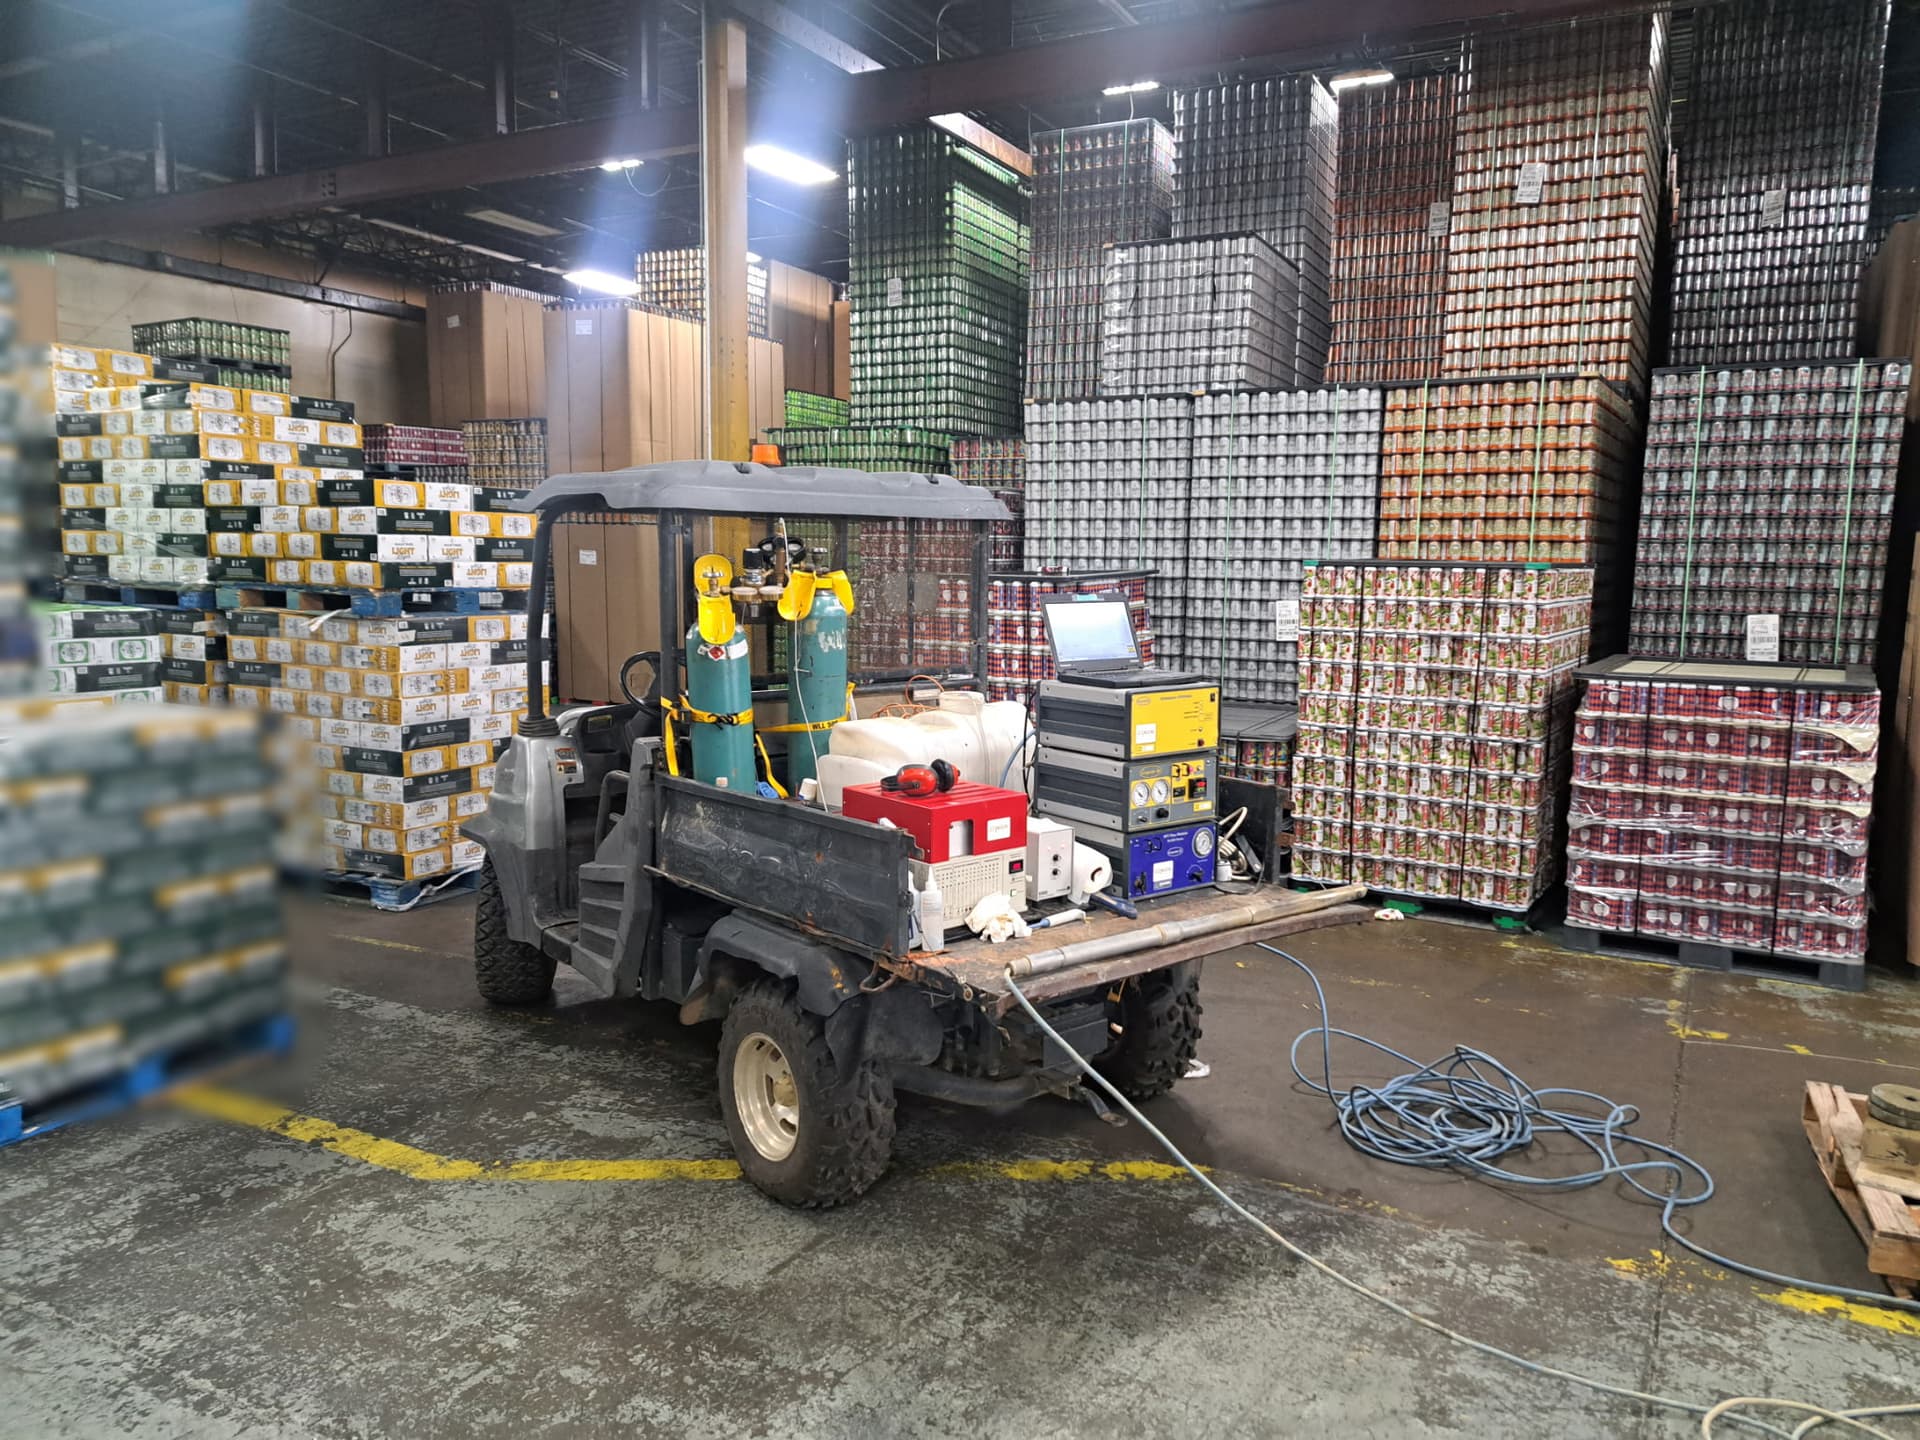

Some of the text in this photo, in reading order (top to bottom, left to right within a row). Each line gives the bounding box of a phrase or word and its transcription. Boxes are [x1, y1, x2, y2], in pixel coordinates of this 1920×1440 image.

[439, 490, 460, 499] LIGHT
[392, 547, 415, 556] LIGHT
[442, 547, 463, 556] LIGHT
[466, 568, 487, 576] LIGHT
[414, 651, 436, 661] LIGHT
[481, 671, 501, 681] LIGHT
[461, 697, 482, 707] LIGHT
[416, 702, 436, 712] LIGHT
